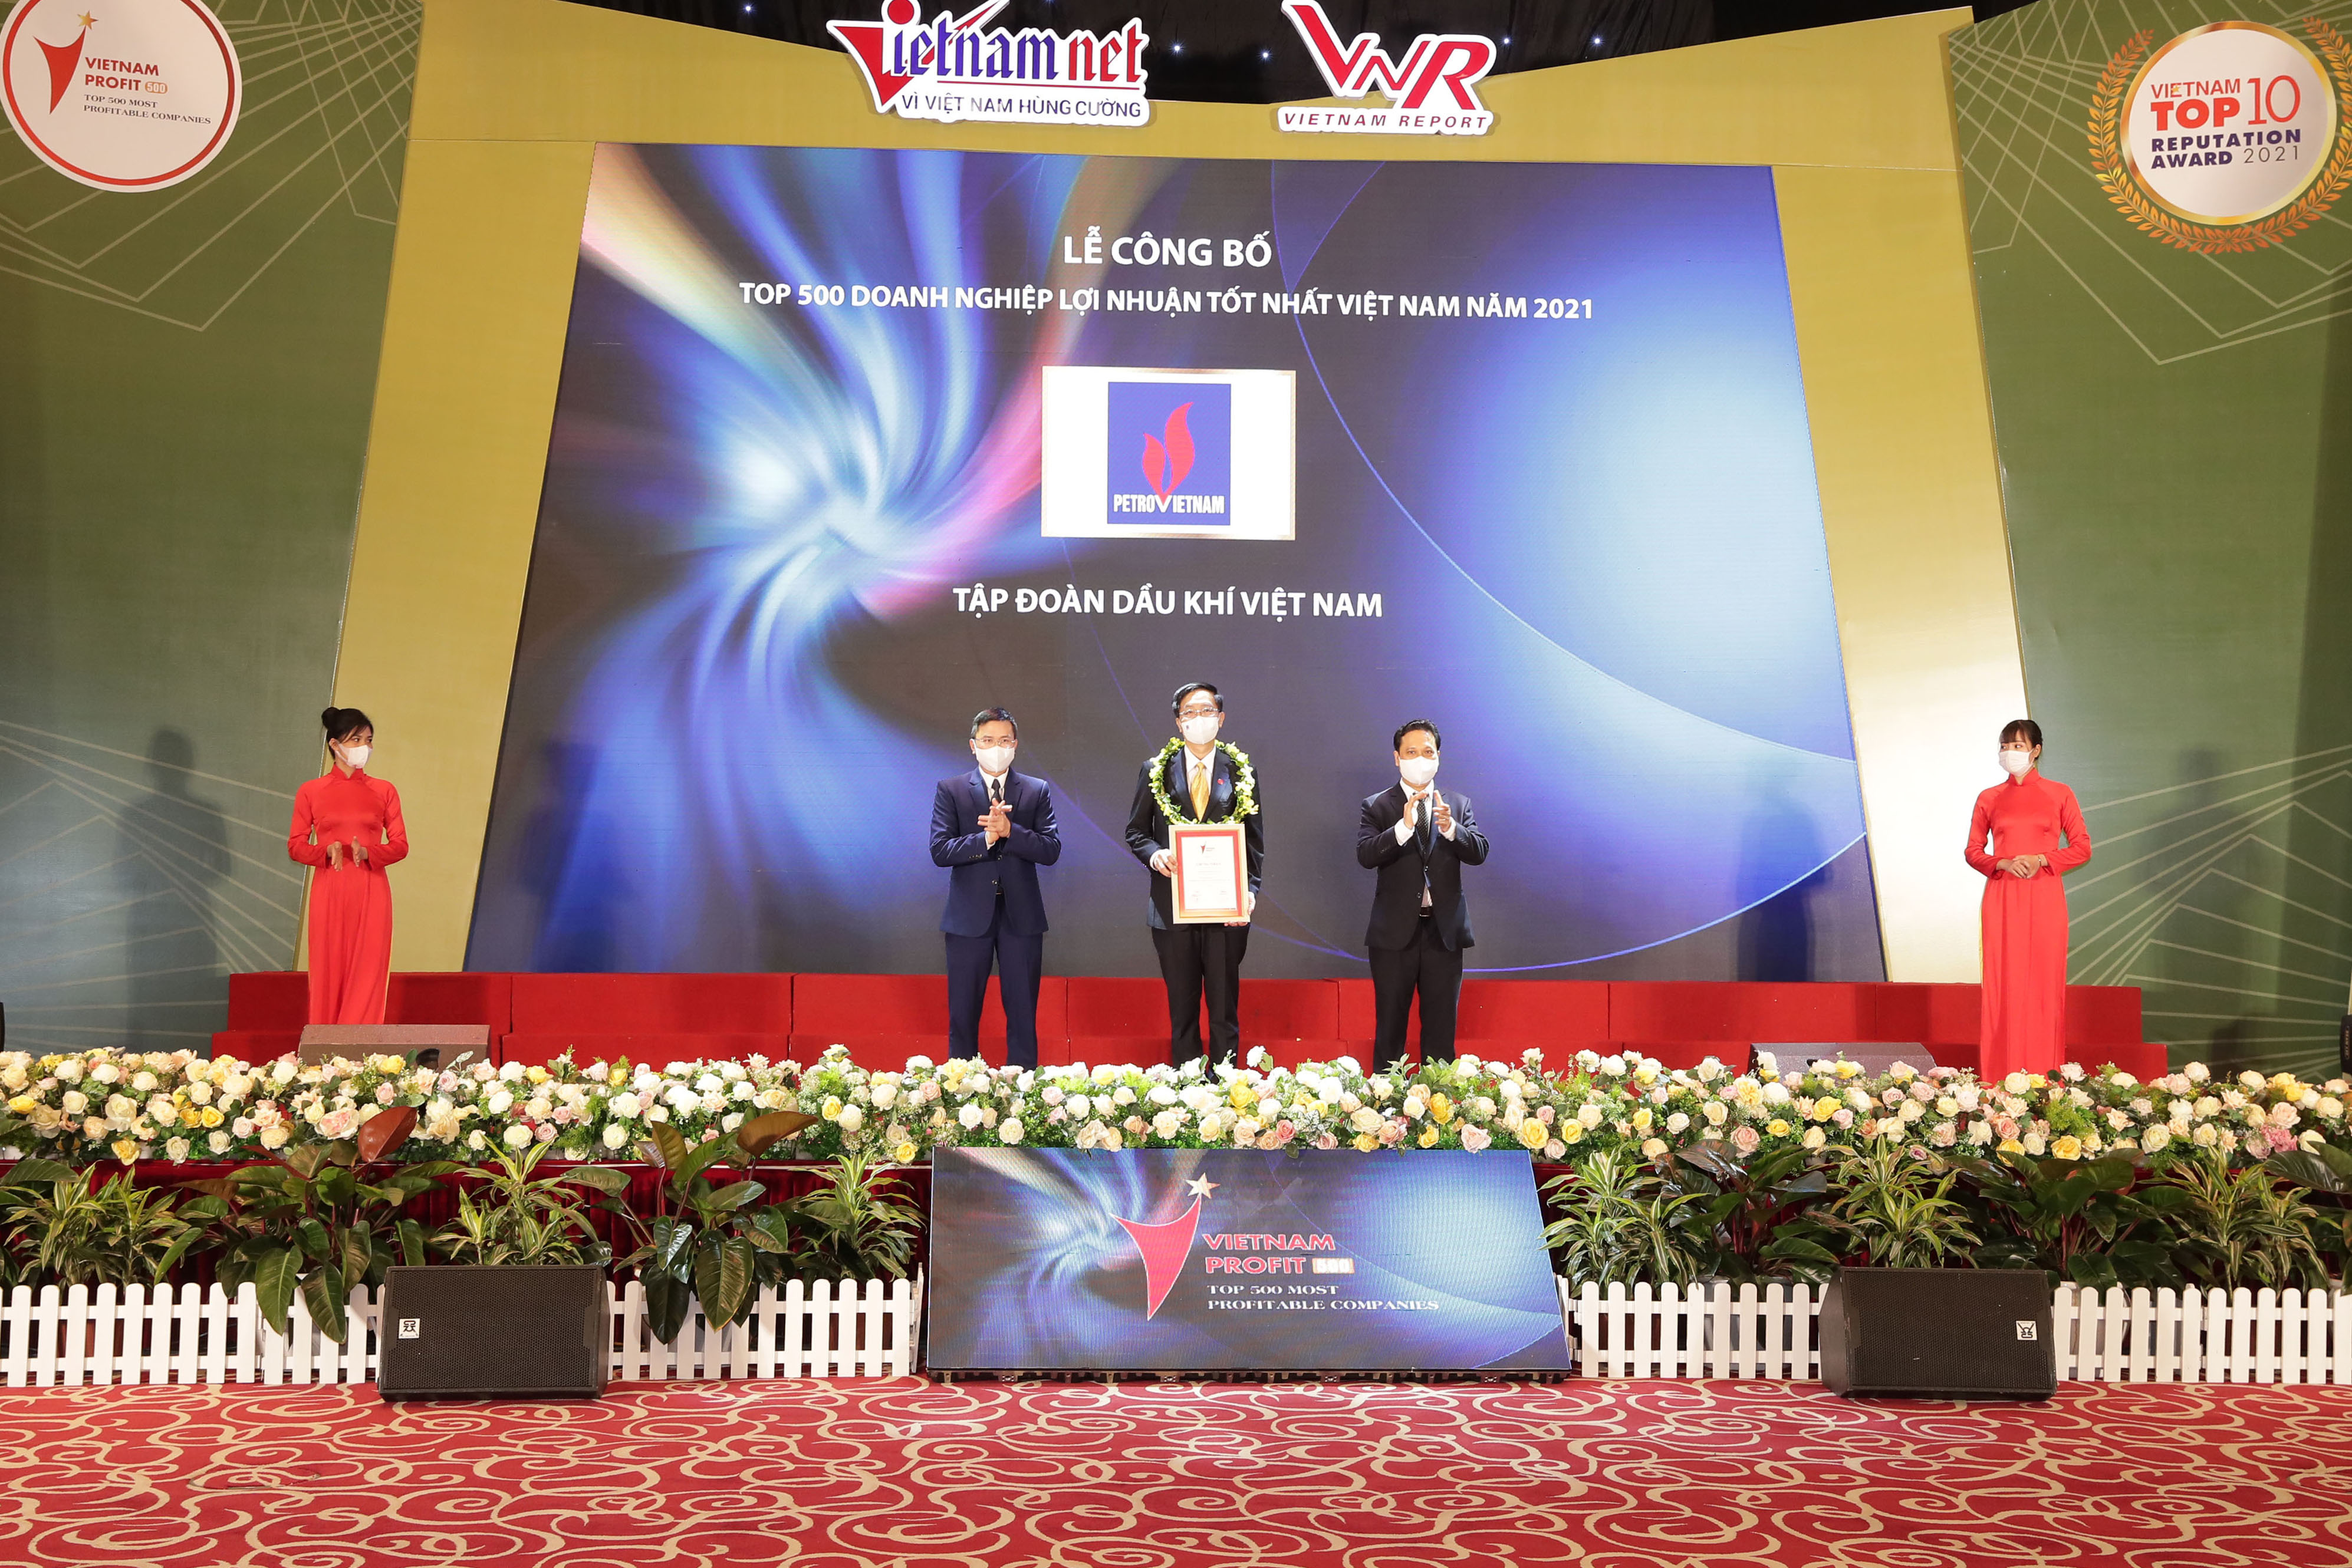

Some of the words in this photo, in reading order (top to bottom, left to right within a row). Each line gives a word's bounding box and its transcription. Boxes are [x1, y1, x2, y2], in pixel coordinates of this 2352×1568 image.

[85, 57, 159, 76] VIETNAM
[84, 74, 142, 91] PROFIT
[146, 82, 166, 93] 500
[2150, 78, 2241, 98] VIETNAM
[84, 94, 106, 103] TOP
[129, 99, 158, 108] MOST
[902, 92, 919, 110] VÌ
[925, 93, 965, 114] VIỆT
[971, 97, 1012, 113] NAM
[1019, 95, 1071, 115] HÙNG
[1075, 97, 1141, 118] CƯỜNG
[2150, 97, 2241, 131] TOP
[2247, 75, 2301, 125] 10
[84, 105, 149, 118] PROFITABLE
[152, 112, 211, 124] COMPANIES
[1284, 113, 1386, 126] VIETNAM
[1399, 115, 1486, 129] REPORT
[2152, 129, 2301, 152] REPUTATION
[2151, 151, 2232, 169] AWARD
[2244, 146, 2299, 164] 2021
[1064, 226, 1103, 264] LỄ
[1111, 231, 1212, 266] CÔNG
[1223, 230, 1272, 267] BỐ
[739, 282, 791, 305] TOP
[797, 284, 845, 307] 500
[851, 285, 948, 308] DOANH
[955, 284, 1053, 315] NGHIỆP
[1059, 287, 1099, 317] LỢI
[1107, 286, 1201, 318] NHUẬN
[1206, 285, 1256, 313] TỐT
[1262, 287, 1333, 315] NHẤT
[1337, 290, 1393, 322] VIỆT
[1400, 295, 1460, 317] NAM
[1467, 292, 1527, 318] NĂM
[1533, 298, 1592, 319] 2021
[1113, 494, 1225, 514] PETROVIETNAM
[952, 582, 1009, 619] TẬP
[1015, 584, 1104, 614] ĐOÀN
[1113, 582, 1175, 614] DẦU
[1184, 586, 1236, 615] KHÍ
[1240, 587, 1306, 622] VIỆT
[1313, 592, 1382, 617] NAM
[1202, 1234, 1336, 1251] VIETNAM
[1205, 1257, 1306, 1274] PROFIT
[1207, 1284, 1245, 1294] TOP
[1250, 1285, 1283, 1294] 500
[1287, 1285, 1339, 1295] MOST
[1208, 1300, 1325, 1310] PROFITABLE
[1330, 1300, 1439, 1310] COMPANIES
